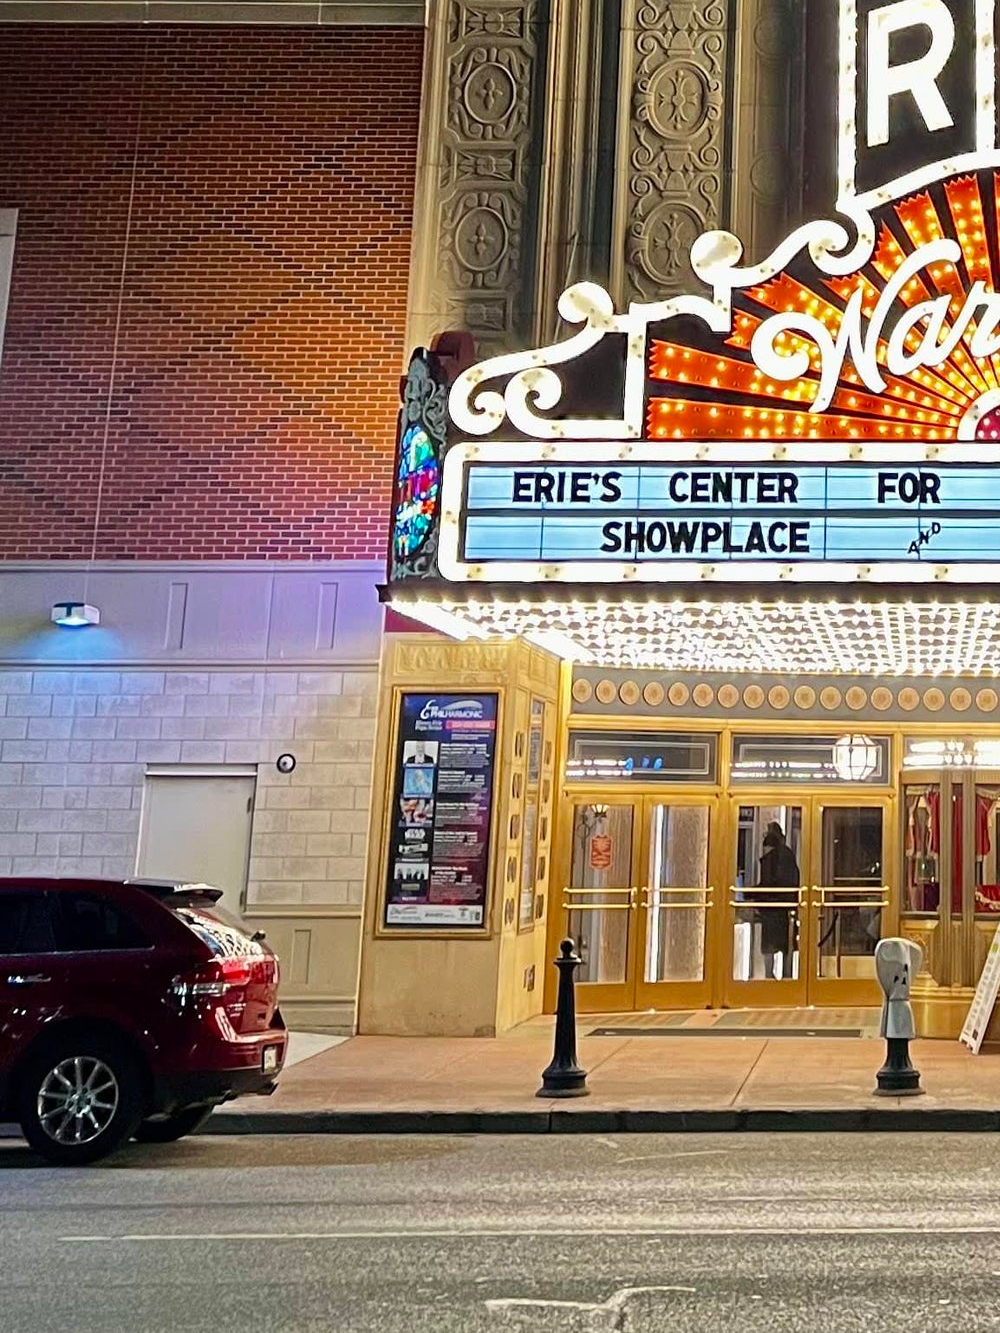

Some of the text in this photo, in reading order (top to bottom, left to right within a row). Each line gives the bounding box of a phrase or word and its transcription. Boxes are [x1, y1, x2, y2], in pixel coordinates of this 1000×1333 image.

[511, 471, 622, 503] ERIE'S
[668, 471, 799, 504] CENTER
[877, 471, 942, 504] FOR
[600, 521, 811, 554] SHOWPLACE
[907, 521, 941, 554] AND
